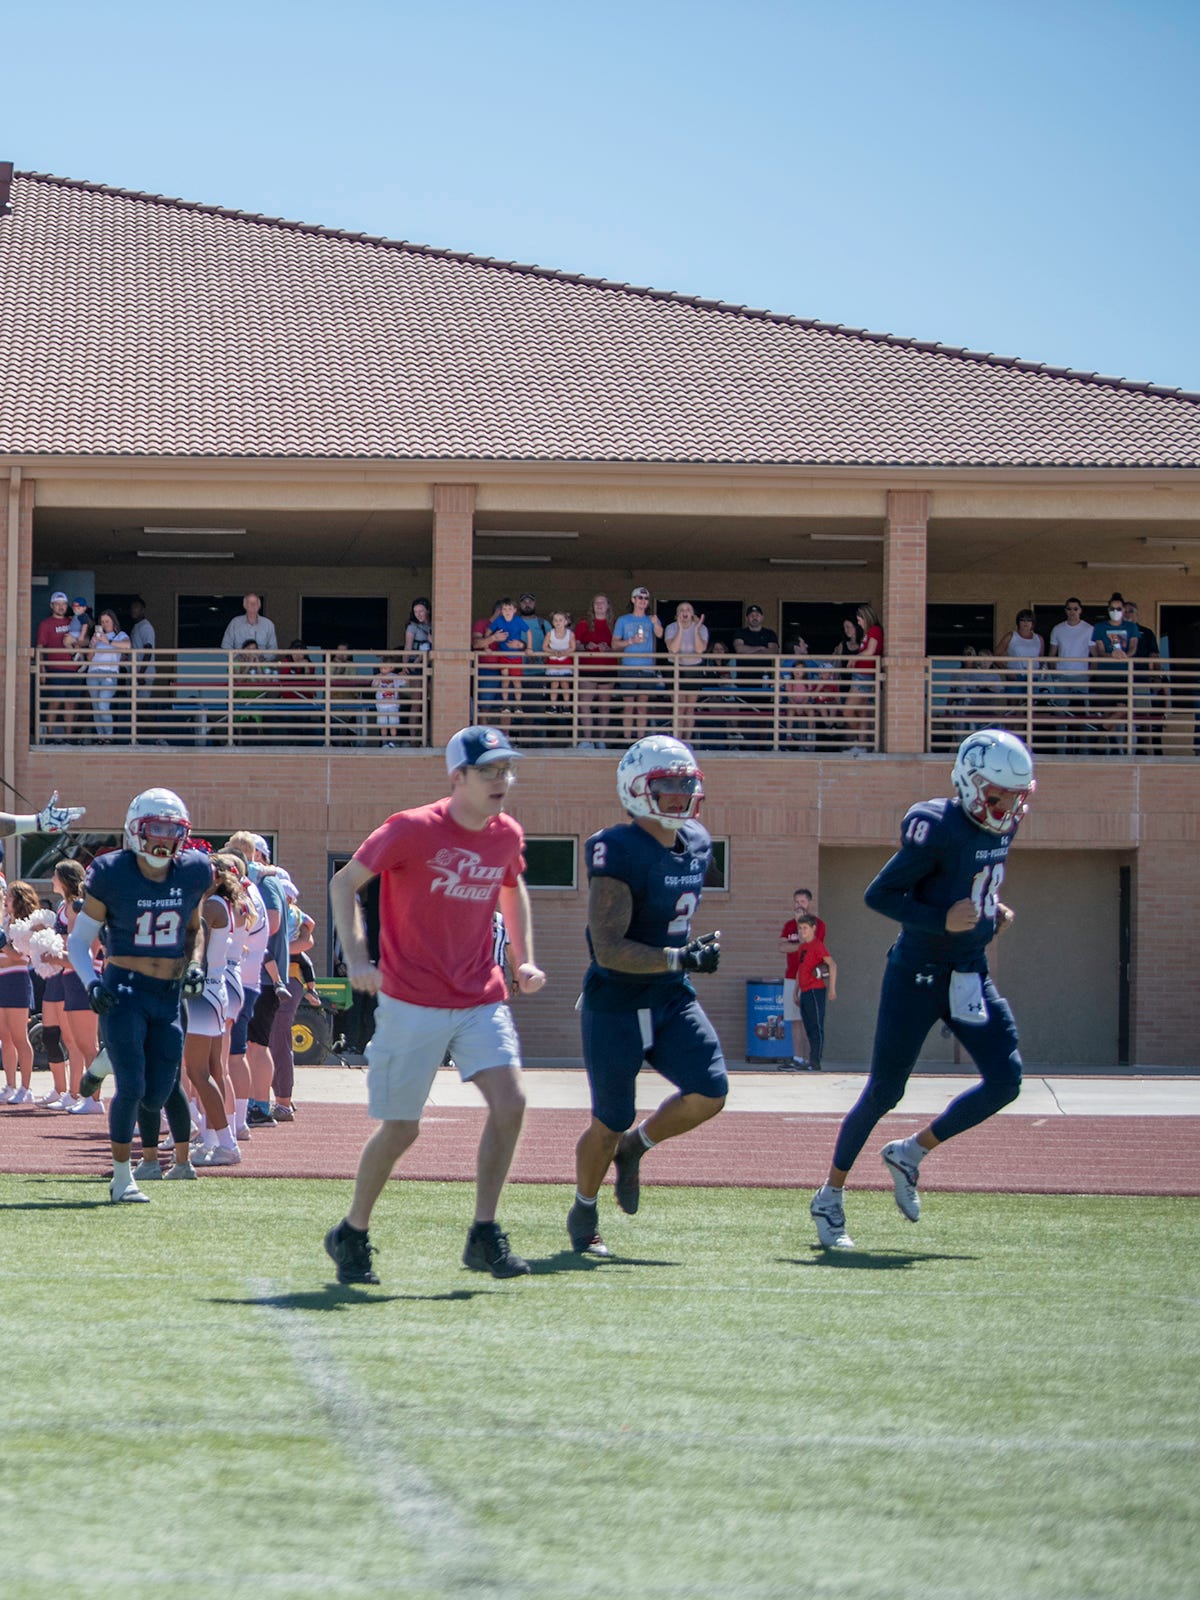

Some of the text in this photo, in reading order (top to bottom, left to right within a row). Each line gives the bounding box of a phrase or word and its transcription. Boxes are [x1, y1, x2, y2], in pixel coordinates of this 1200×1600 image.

[905, 817, 930, 845] 18
[592, 842, 607, 869] 2
[427, 864, 497, 901] Planet
[971, 862, 1005, 919] 18
[137, 898, 183, 908] CSU-PUEBLO
[667, 891, 699, 936] 2
[134, 910, 181, 947] 12
